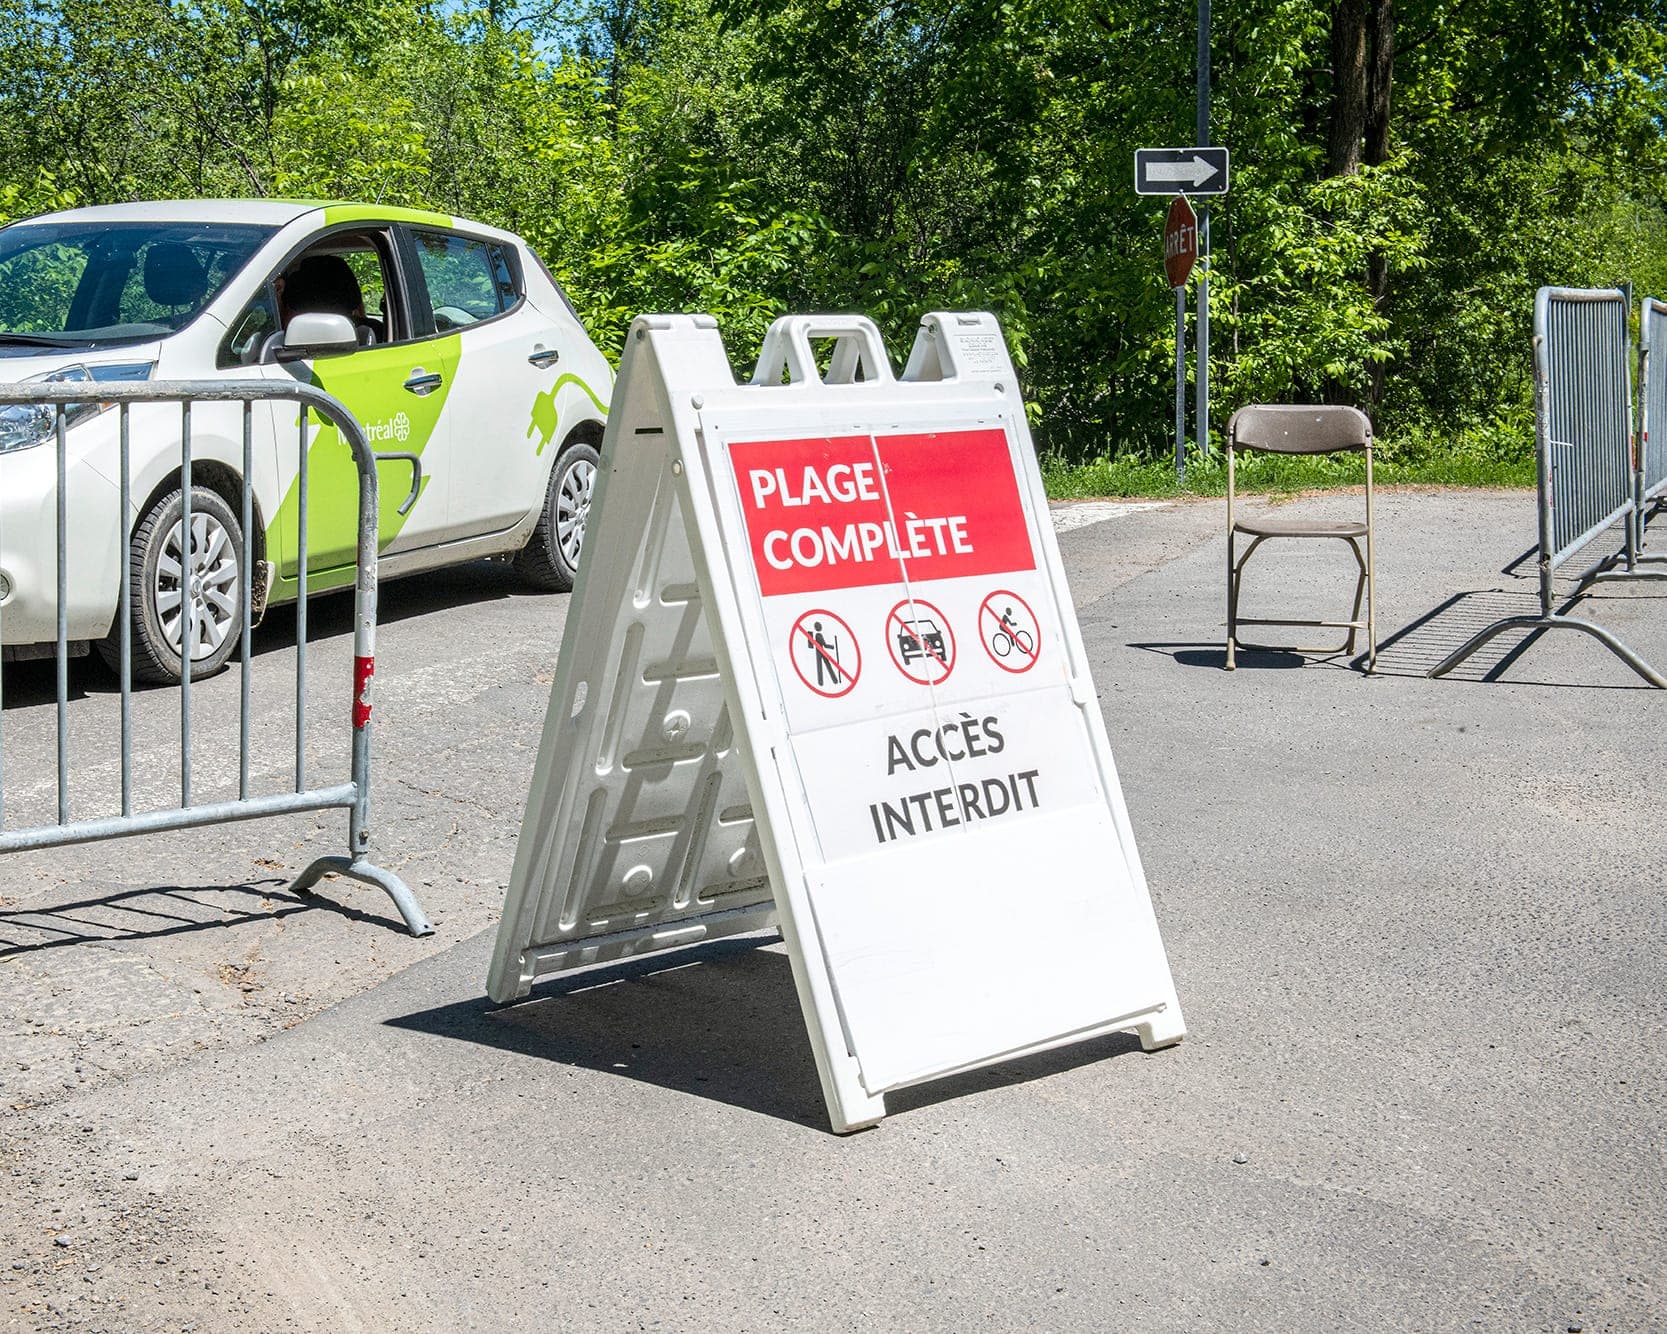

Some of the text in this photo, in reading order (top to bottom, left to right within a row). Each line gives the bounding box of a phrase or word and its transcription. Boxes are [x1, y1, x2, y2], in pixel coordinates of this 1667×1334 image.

[749, 462, 880, 508] PLAGE
[763, 512, 974, 569] COMPLÈTE
[887, 712, 1005, 775] ACCÈS
[869, 769, 1039, 843] INTERDIT
